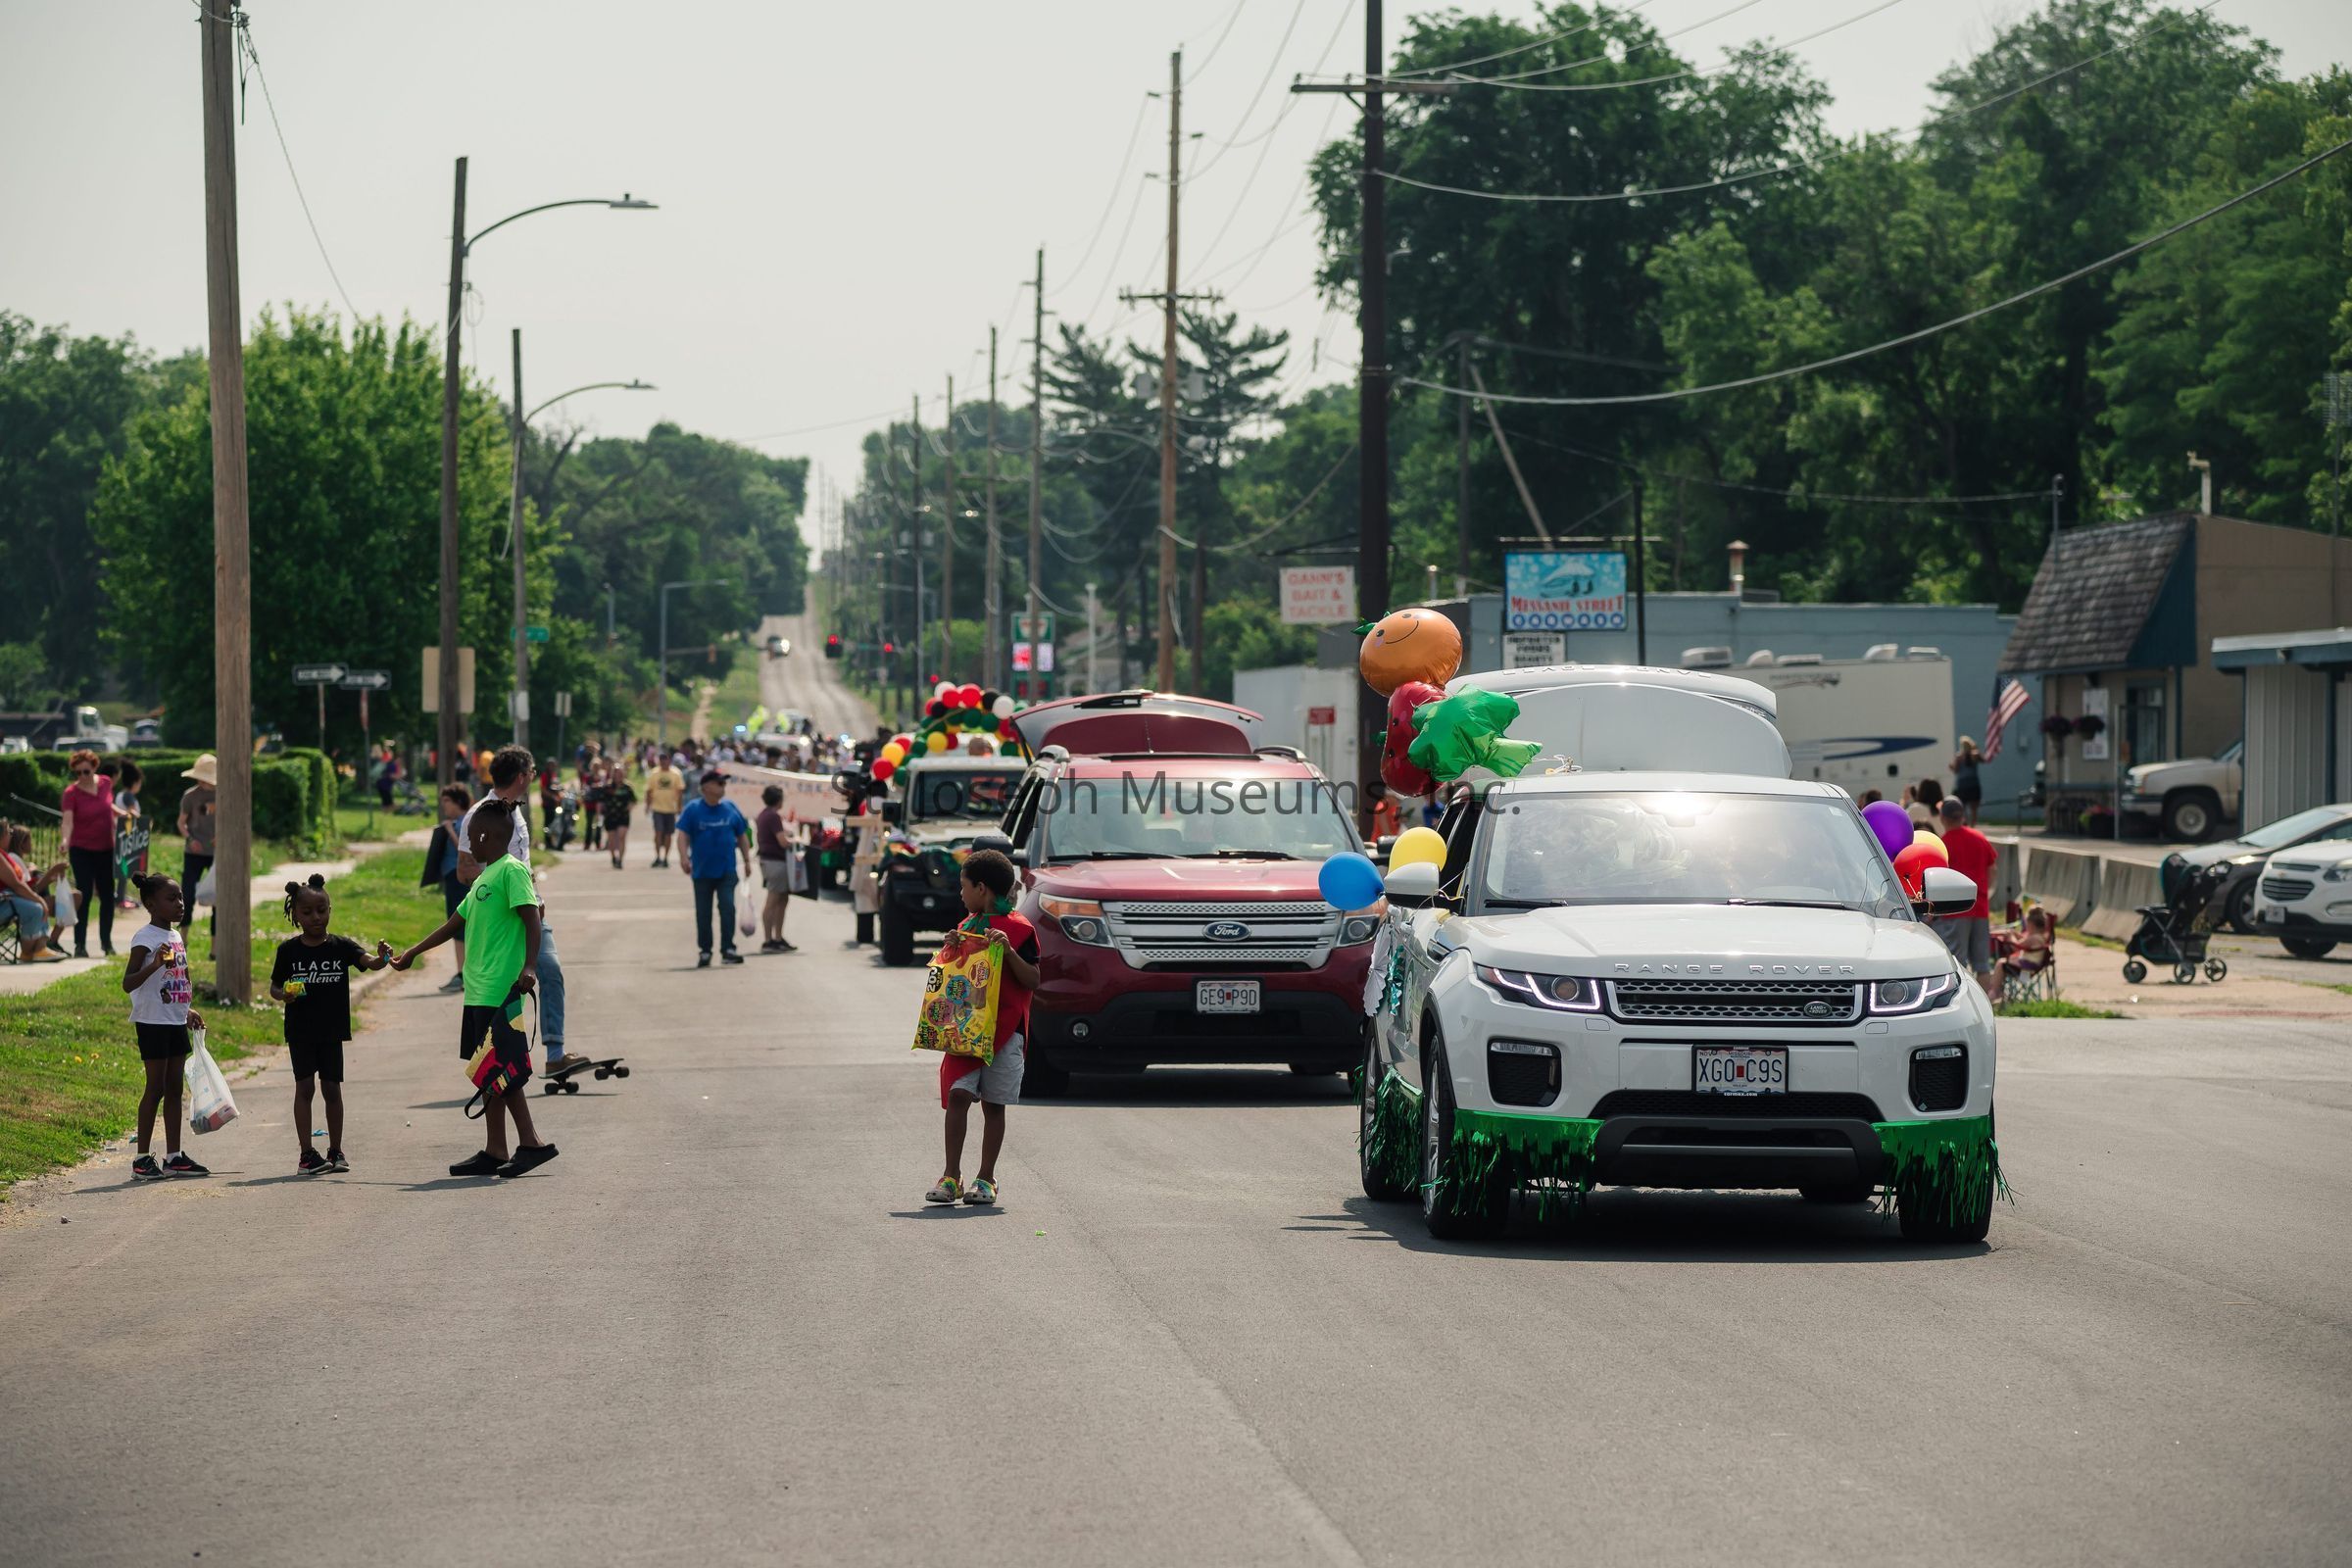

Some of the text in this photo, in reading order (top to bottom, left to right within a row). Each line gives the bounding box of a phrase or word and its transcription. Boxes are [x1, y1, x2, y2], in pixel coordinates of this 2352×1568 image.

[1214, 924, 1240, 936] Ford
[292, 960, 341, 971] LACK
[1614, 963, 1855, 975] RANGE ROVER
[1200, 988, 1257, 1005] GE9 P9D
[1745, 1058, 1783, 1083] C9S
